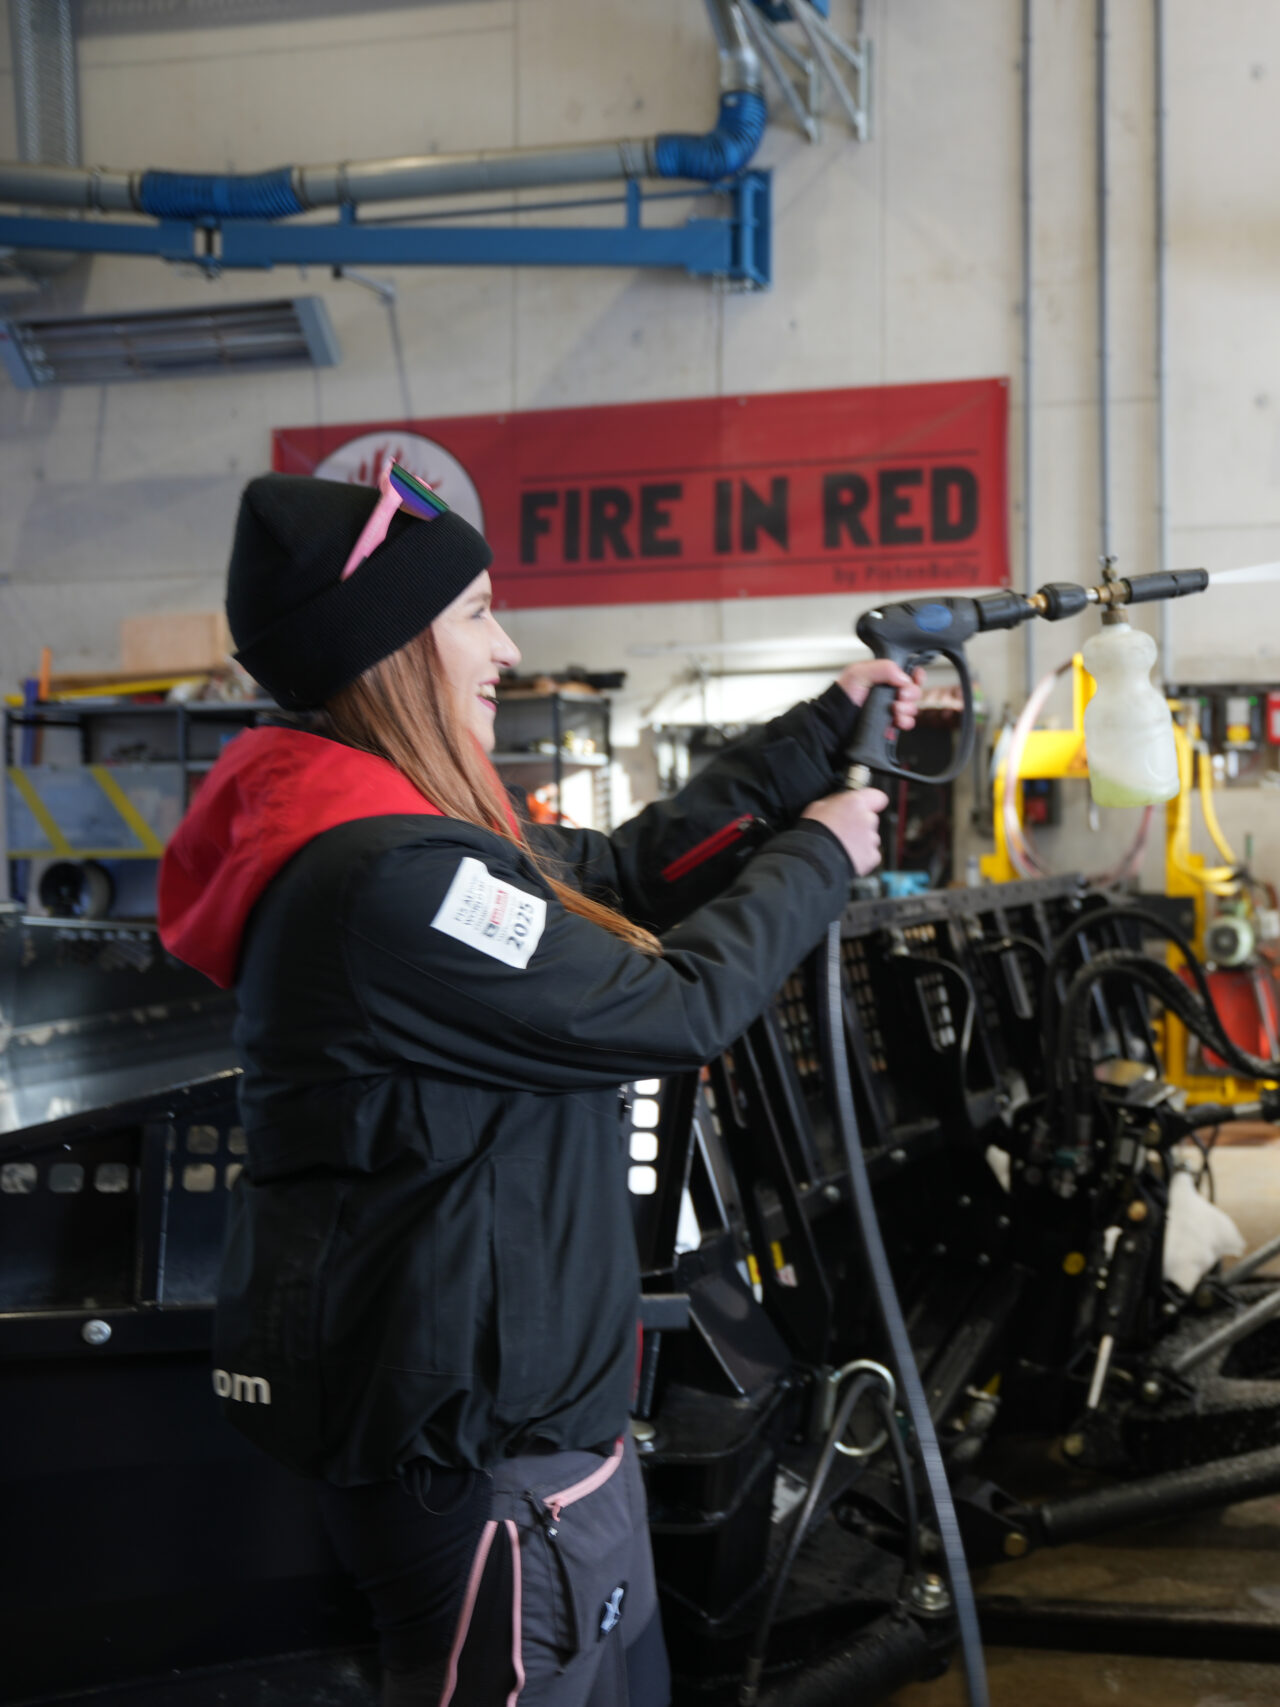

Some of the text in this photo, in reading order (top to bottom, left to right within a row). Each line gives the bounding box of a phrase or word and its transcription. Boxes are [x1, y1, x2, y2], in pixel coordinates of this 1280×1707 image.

[520, 465, 979, 565] FIRE IN RED
[507, 902, 534, 950] 2025
[212, 1368, 271, 1405] om
